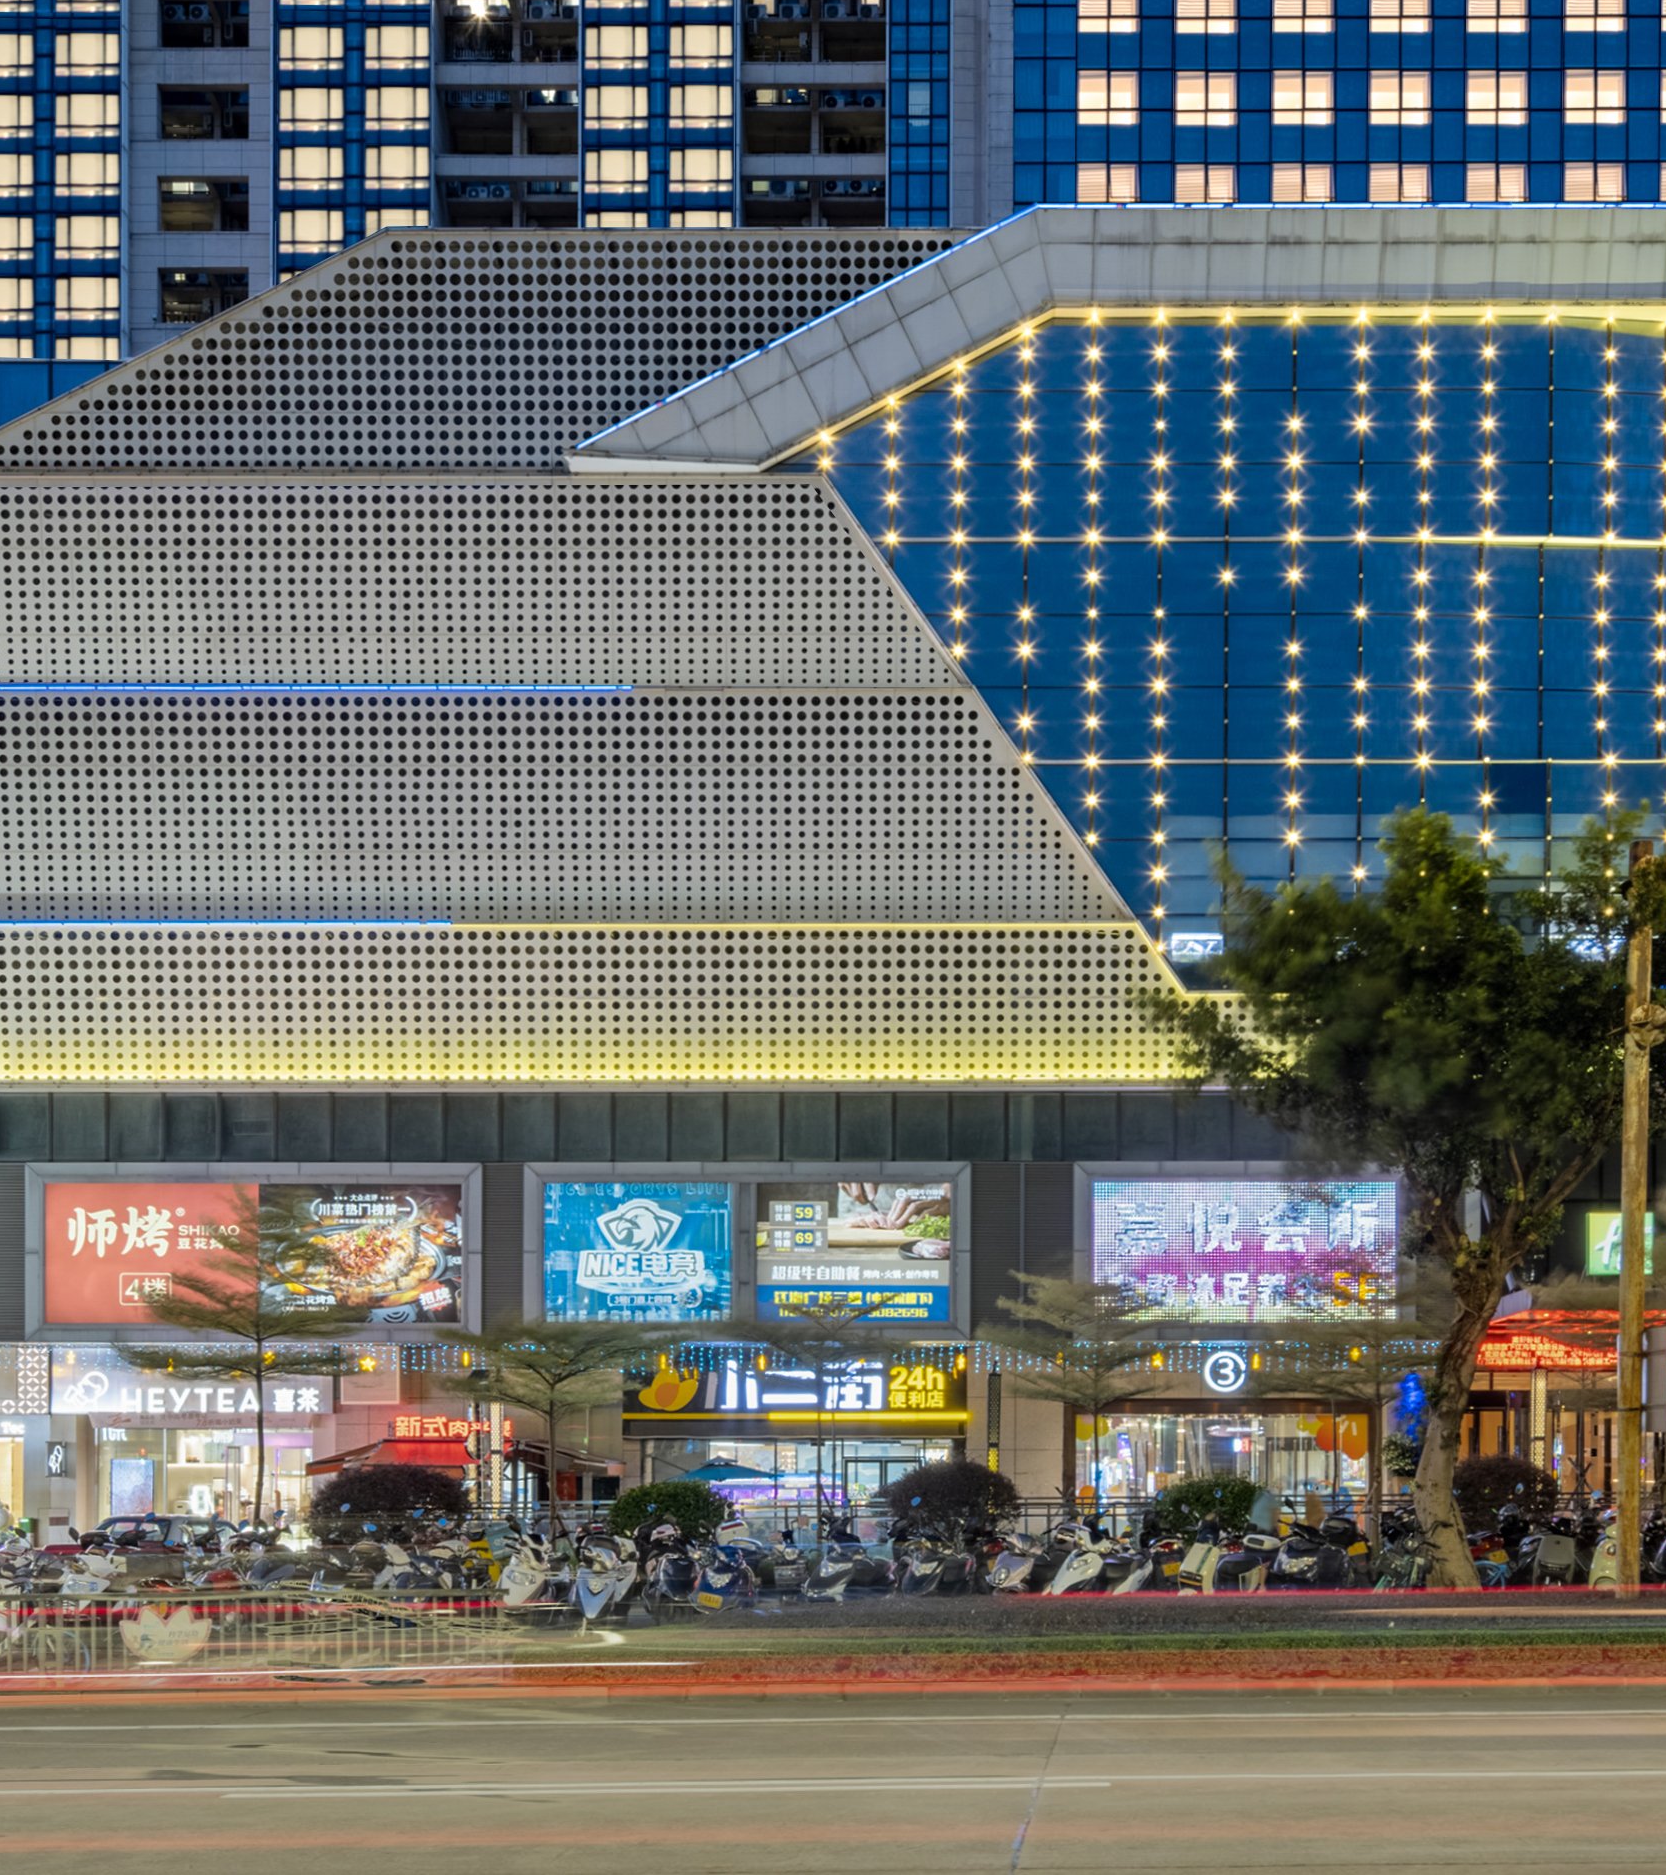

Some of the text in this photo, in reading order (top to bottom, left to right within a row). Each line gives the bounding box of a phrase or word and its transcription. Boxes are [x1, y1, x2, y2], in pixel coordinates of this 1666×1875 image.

[795, 1207, 813, 1219] 59
[68, 1206, 174, 1258] 师烤
[178, 1225, 240, 1236] SHIKAO
[795, 1232, 813, 1244] 69
[1115, 1201, 1379, 1255] 嘉悦会所
[584, 1252, 699, 1278] NICE电竞
[772, 1266, 860, 1280] 超级牛自助餐
[889, 1366, 945, 1390] 24h
[121, 1388, 320, 1412] HEYTEA 喜茶
[888, 1390, 945, 1408] 便利店
